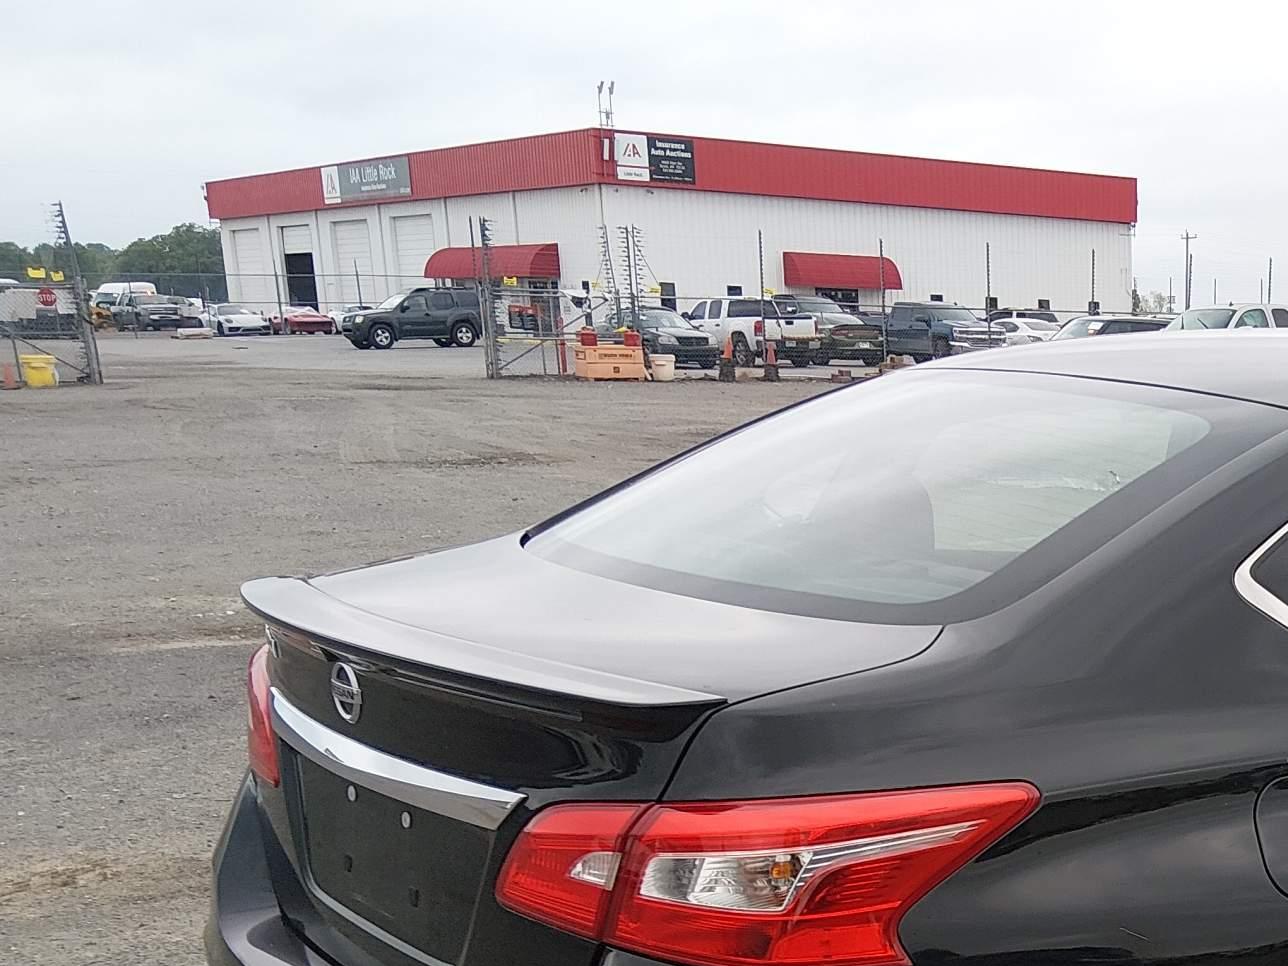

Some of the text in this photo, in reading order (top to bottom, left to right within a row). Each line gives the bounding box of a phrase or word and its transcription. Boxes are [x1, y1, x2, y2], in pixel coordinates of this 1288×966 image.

[650, 148, 692, 159] Auto Auctions
[349, 163, 397, 184] IAA Little Rock
[39, 294, 56, 303] STOP
